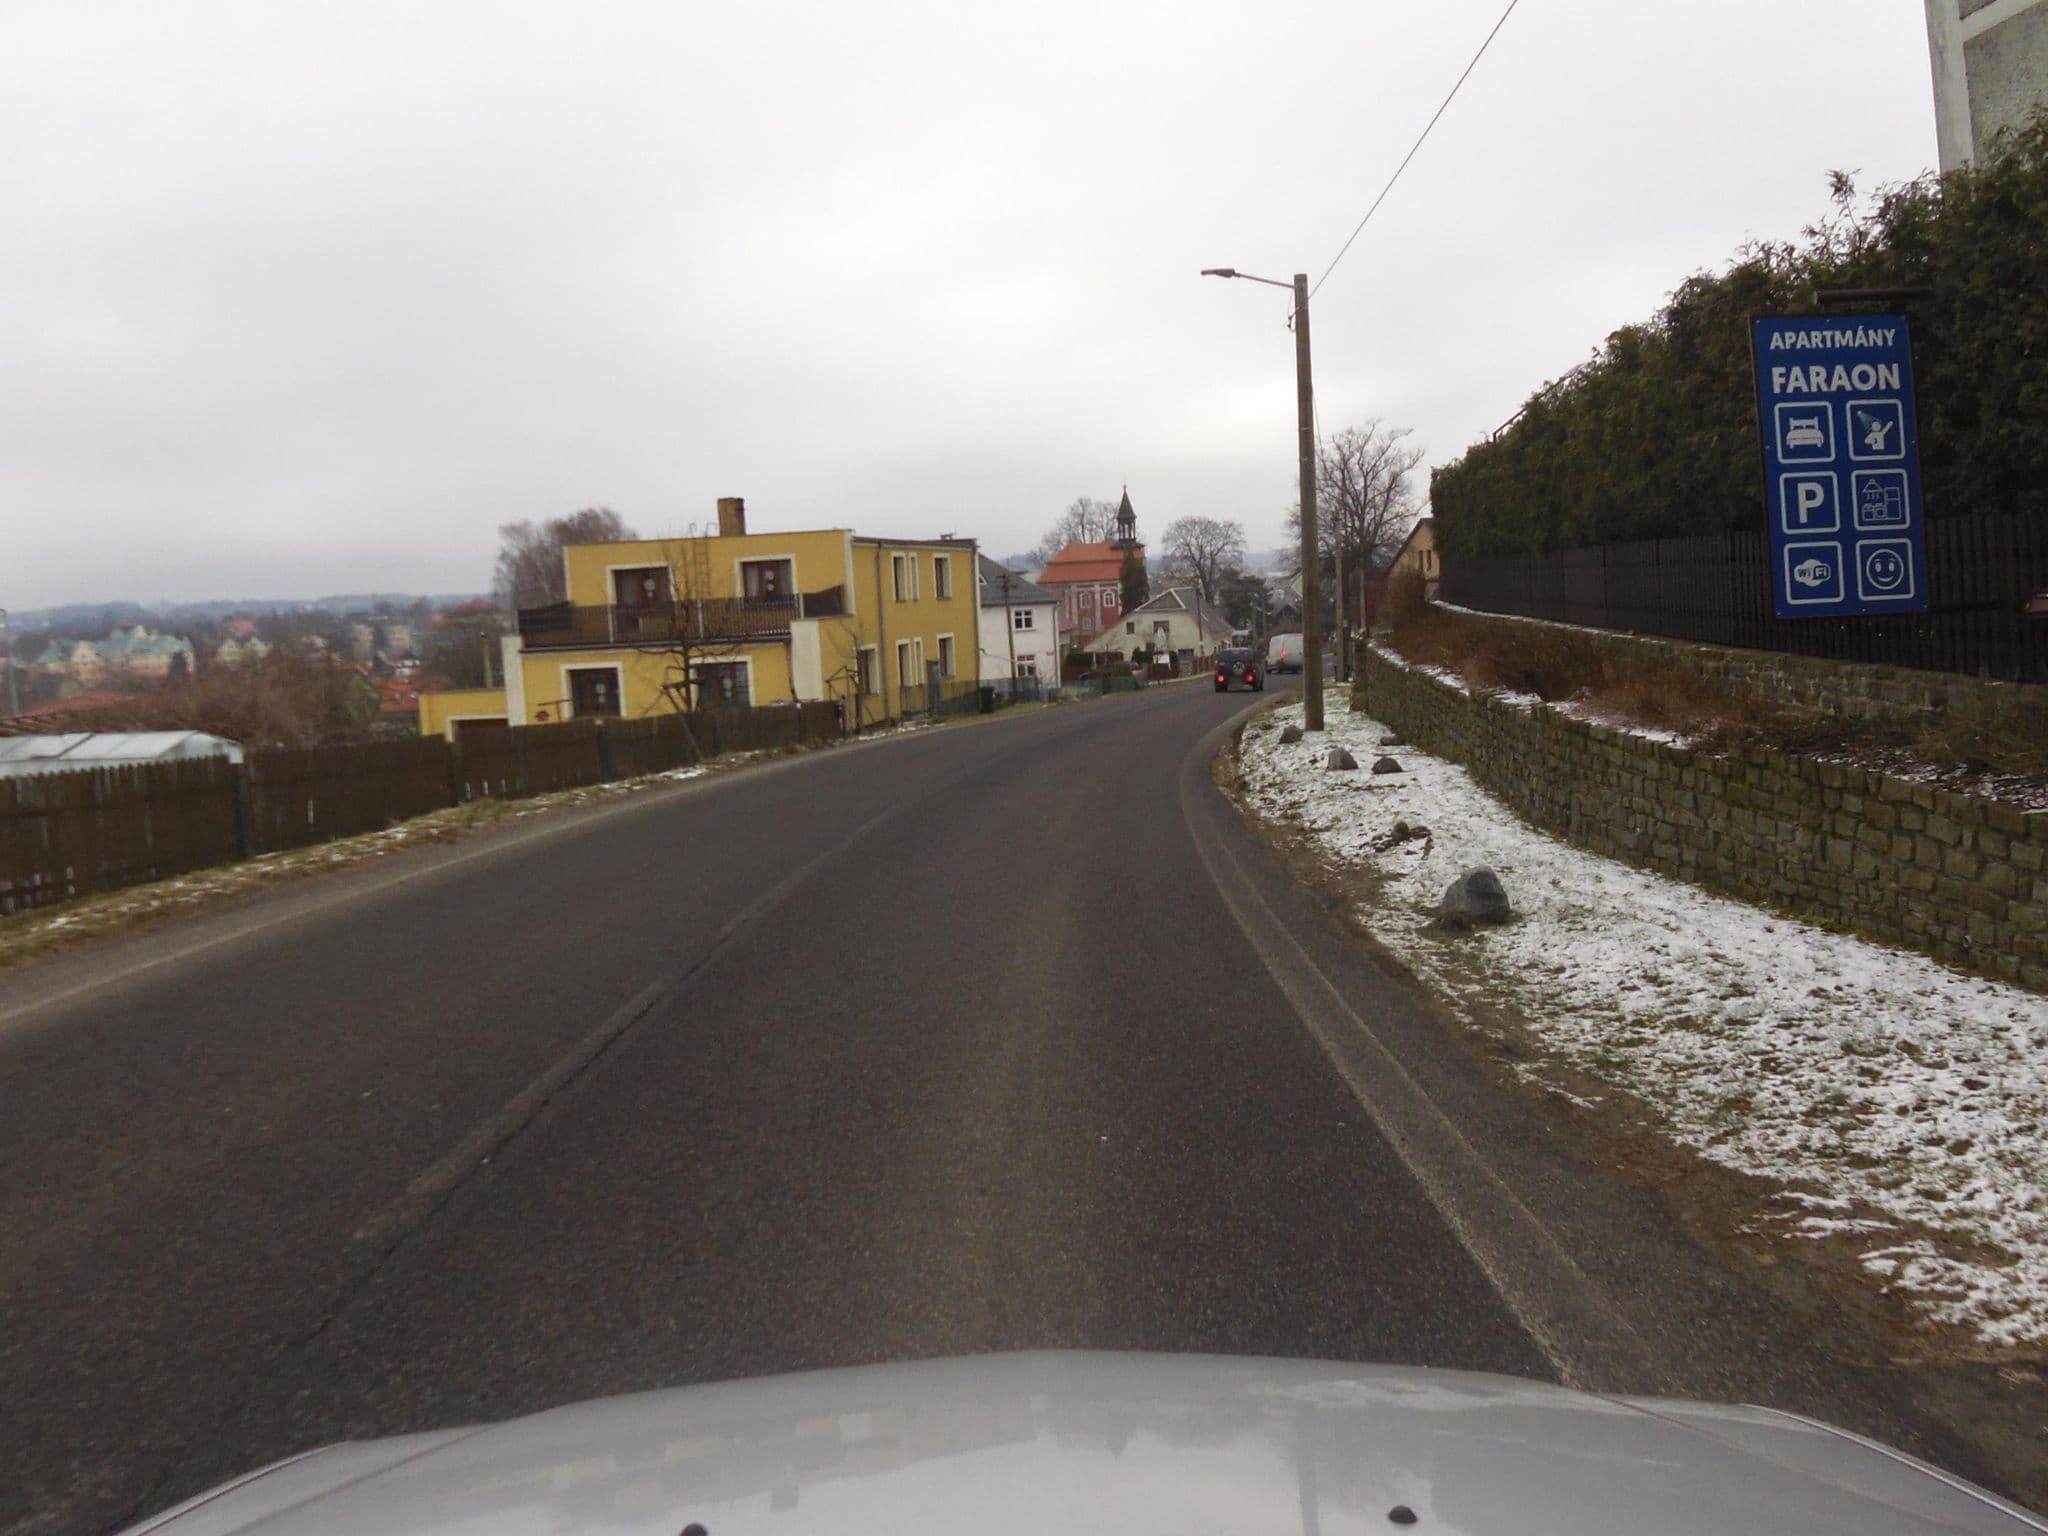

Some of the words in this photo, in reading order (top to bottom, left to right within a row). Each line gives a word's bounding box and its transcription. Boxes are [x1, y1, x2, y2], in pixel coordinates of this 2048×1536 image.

[1769, 325, 1896, 350] APARTMÁNY
[1771, 363, 1901, 394] FARAON
[1797, 481, 1825, 524] P
